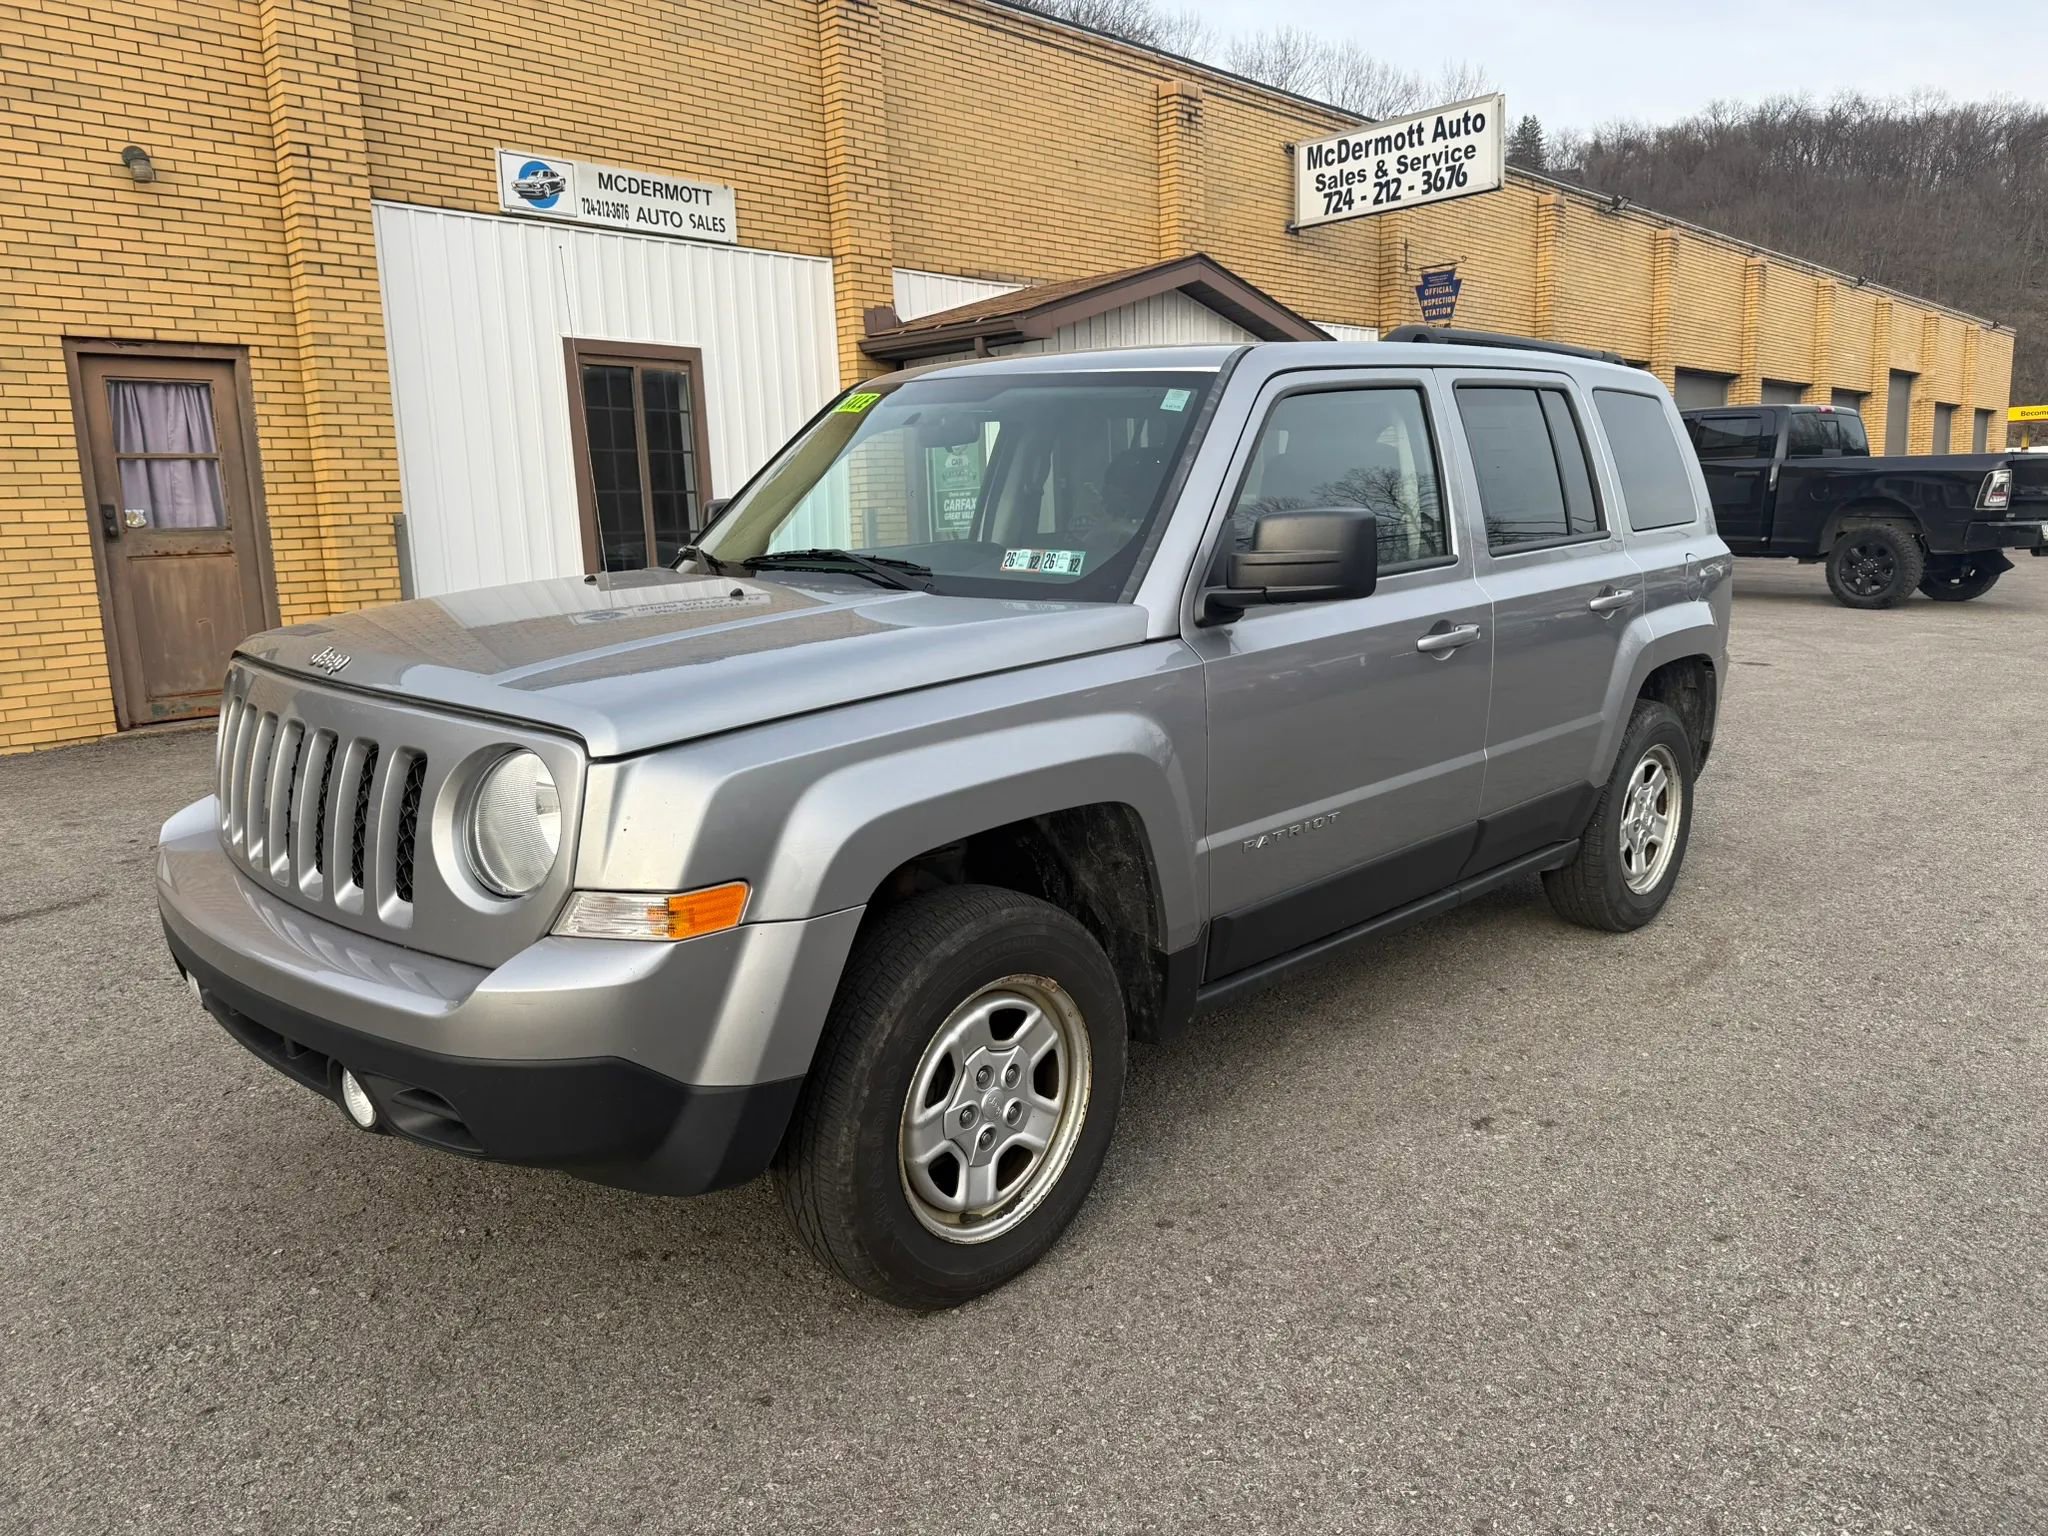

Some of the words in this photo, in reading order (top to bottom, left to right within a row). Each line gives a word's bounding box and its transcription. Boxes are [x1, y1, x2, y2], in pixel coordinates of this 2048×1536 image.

[1307, 121, 1424, 171] McDermott
[1431, 110, 1486, 143] Auto
[1315, 168, 1367, 193] Sales
[1374, 159, 1388, 180] &
[1396, 144, 1477, 174] Service
[598, 172, 712, 206] MCDERMOTT
[1323, 187, 1354, 215] 724
[1373, 178, 1402, 205] 212
[1421, 163, 1467, 195] 3676
[581, 197, 630, 221] 724-212-3676
[636, 206, 683, 228] AUTO
[689, 213, 726, 233] SALES
[1424, 285, 1453, 296] OFFICIAL
[1421, 296, 1456, 307] INSPECTION
[1425, 307, 1451, 318] STATION
[2021, 409, 2048, 417] Becom
[944, 498, 977, 512] CARFAX
[1004, 552, 1016, 567] 26
[1029, 556, 1041, 569] 12
[1044, 553, 1056, 569] 26
[1069, 558, 1081, 572] 12
[310, 646, 351, 675] Jeep
[1242, 812, 1341, 853] PATRIOT
